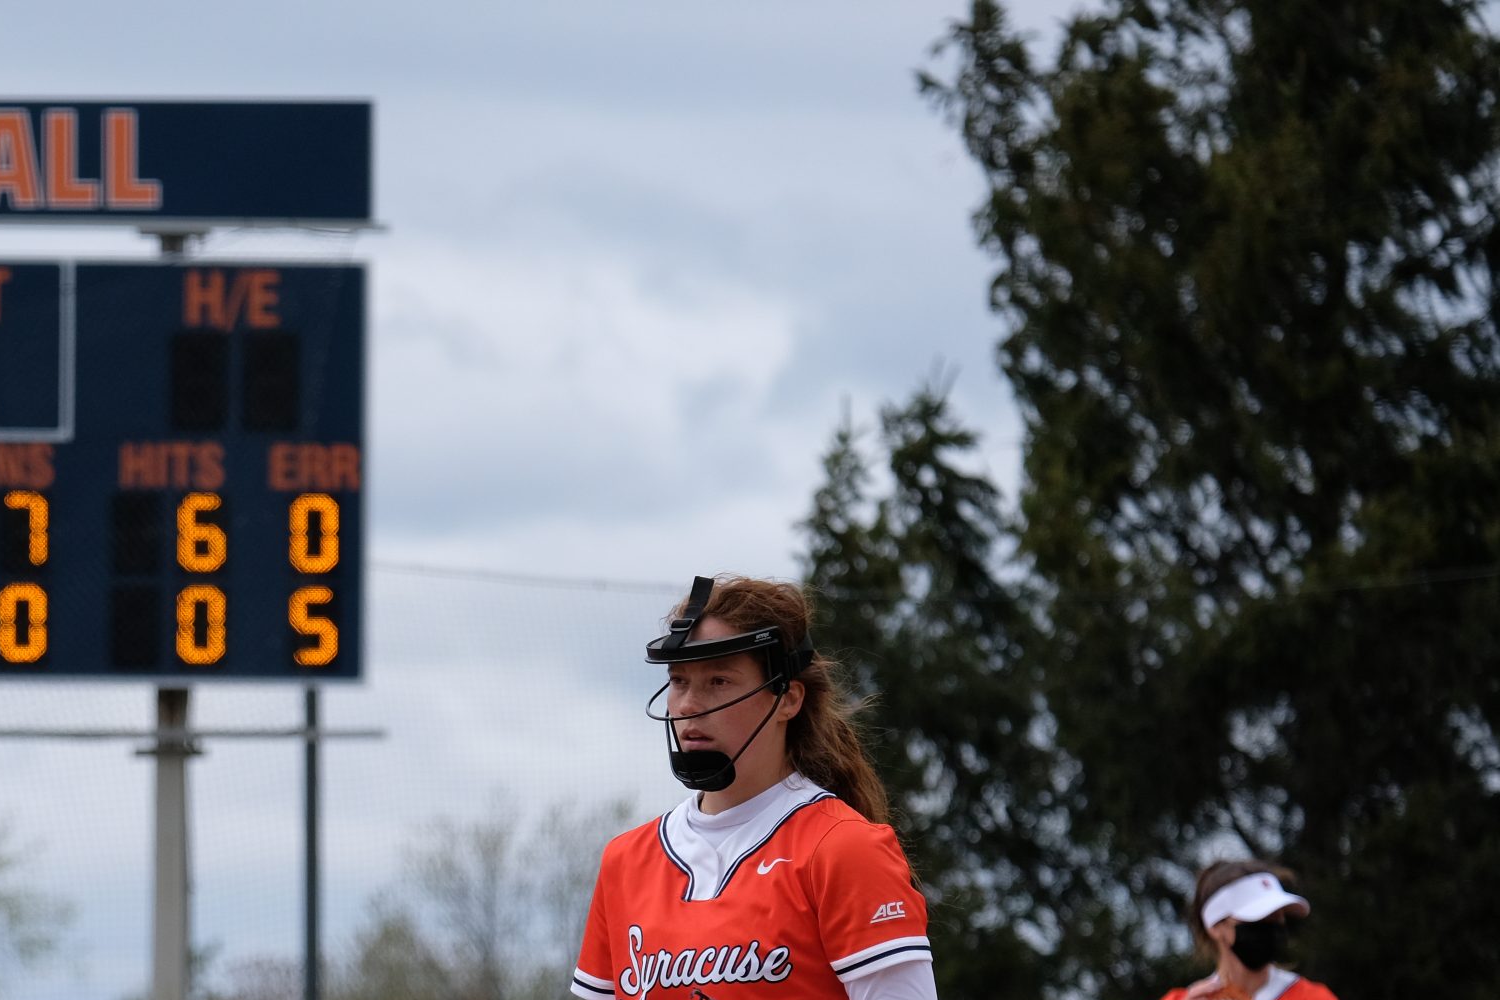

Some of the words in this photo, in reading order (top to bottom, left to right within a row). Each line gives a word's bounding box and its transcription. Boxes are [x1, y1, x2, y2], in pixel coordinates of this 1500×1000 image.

[184, 269, 280, 328] H/E
[120, 443, 225, 489] HITS
[269, 444, 360, 489] ERR
[4, 490, 48, 566] 7
[177, 493, 226, 572] 6
[289, 494, 339, 573] 0
[176, 586, 226, 664] 0
[289, 587, 338, 666] 5
[871, 901, 906, 920] ACC
